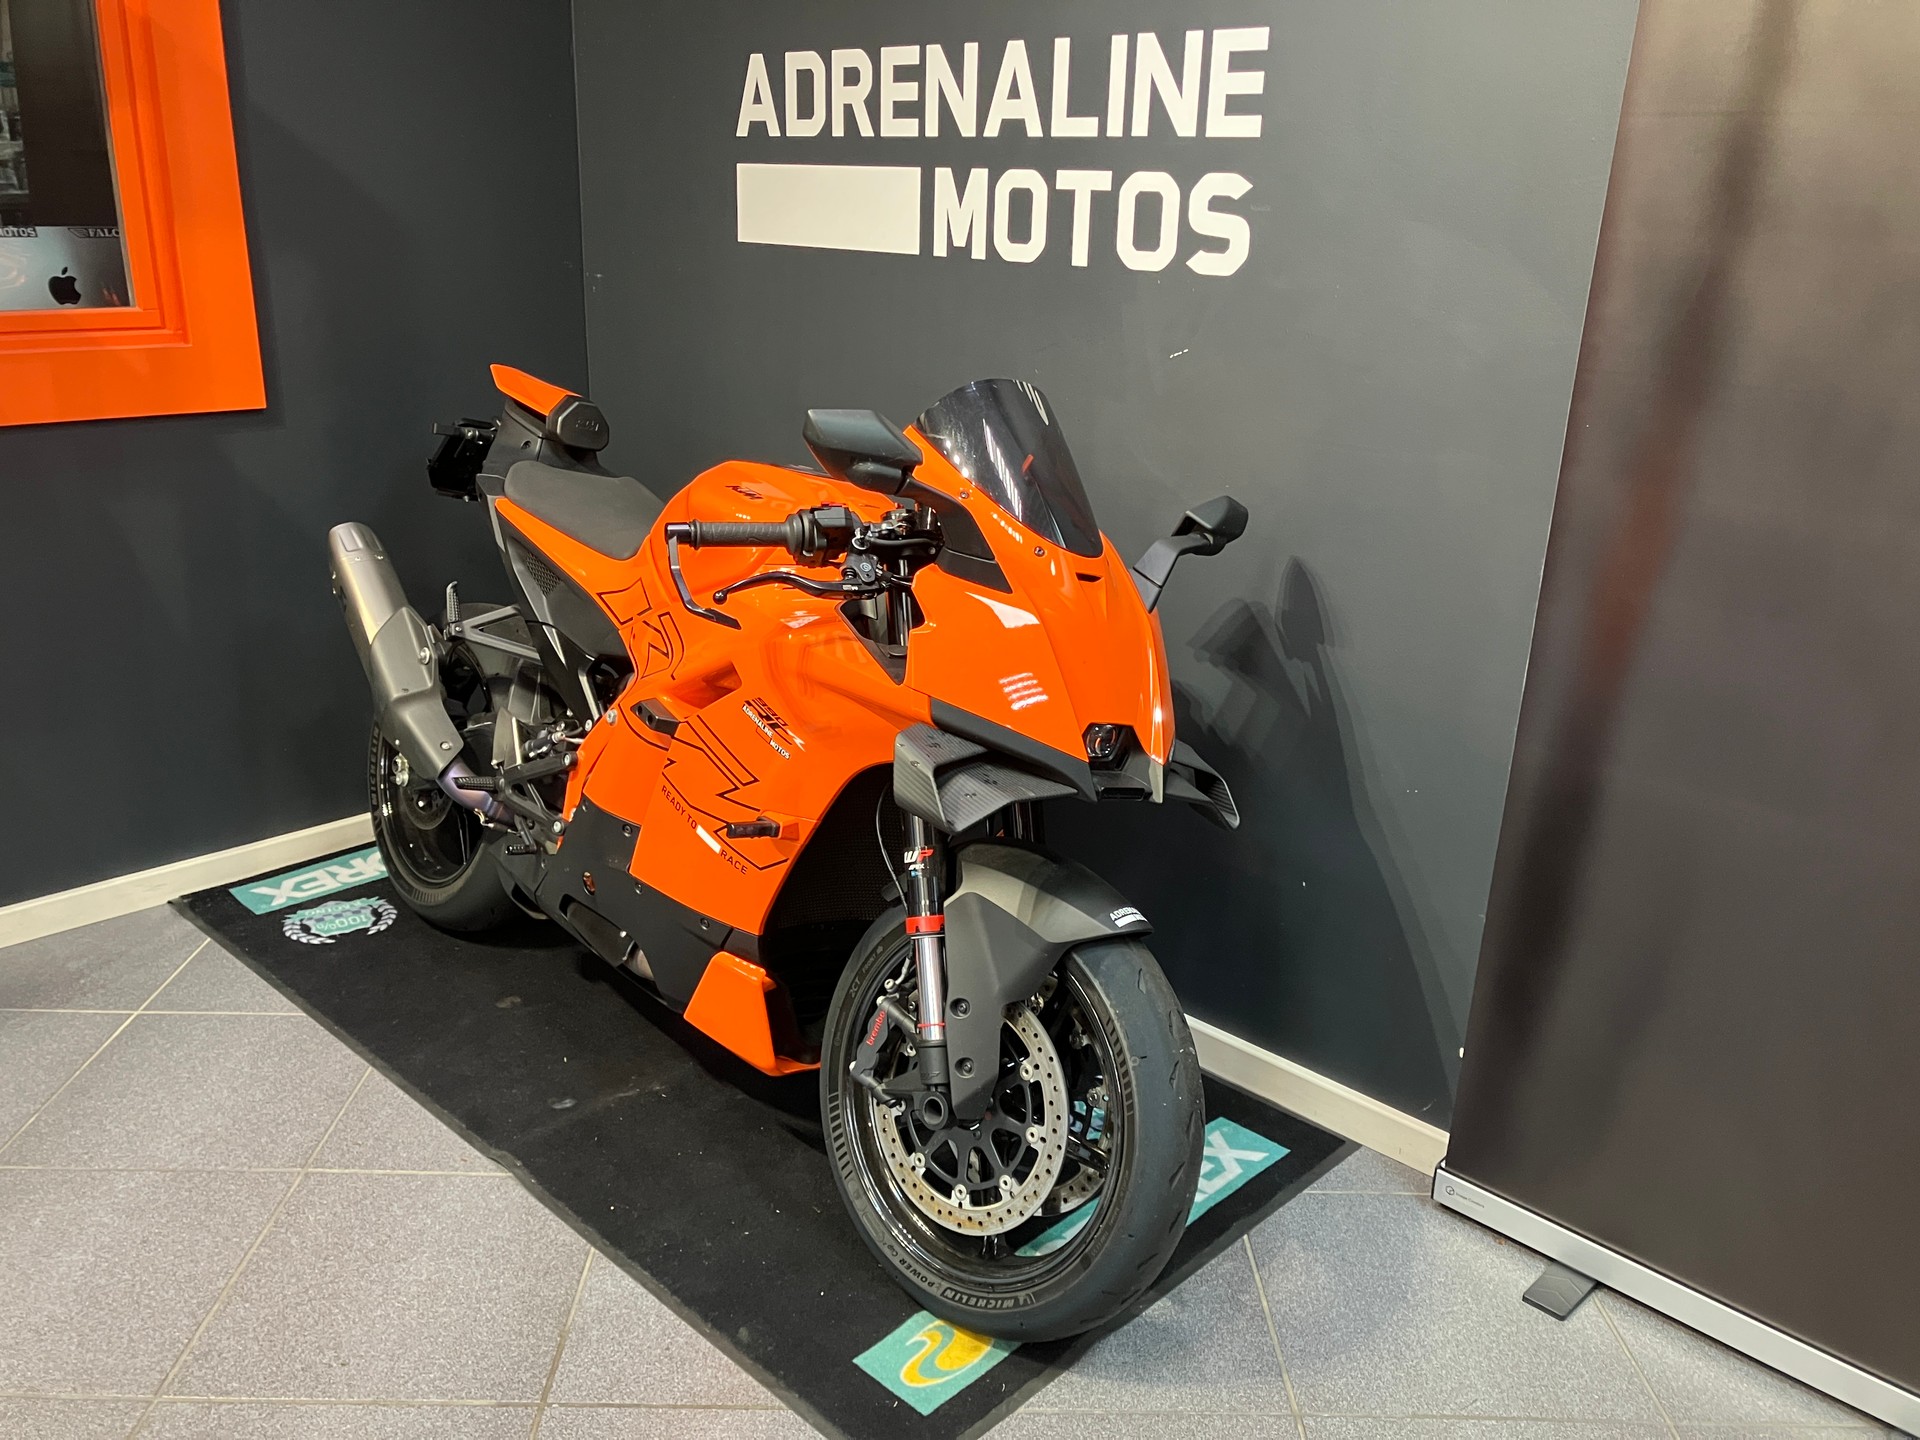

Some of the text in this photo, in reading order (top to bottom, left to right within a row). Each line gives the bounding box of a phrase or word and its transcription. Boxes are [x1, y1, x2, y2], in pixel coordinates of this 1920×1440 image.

[736, 26, 1270, 138] ADRENALINE
[0, 227, 36, 237] OTOS
[933, 168, 1254, 276] MOTOS
[742, 705, 774, 738] ADRENALINE
[769, 740, 791, 760] MOTOS
[661, 785, 748, 875] READY TO RACE
[316, 915, 368, 931] 100%
[866, 1010, 886, 1046] brembo
[899, 1258, 935, 1287] POWER
[943, 1288, 1015, 1309] MICHELIN
